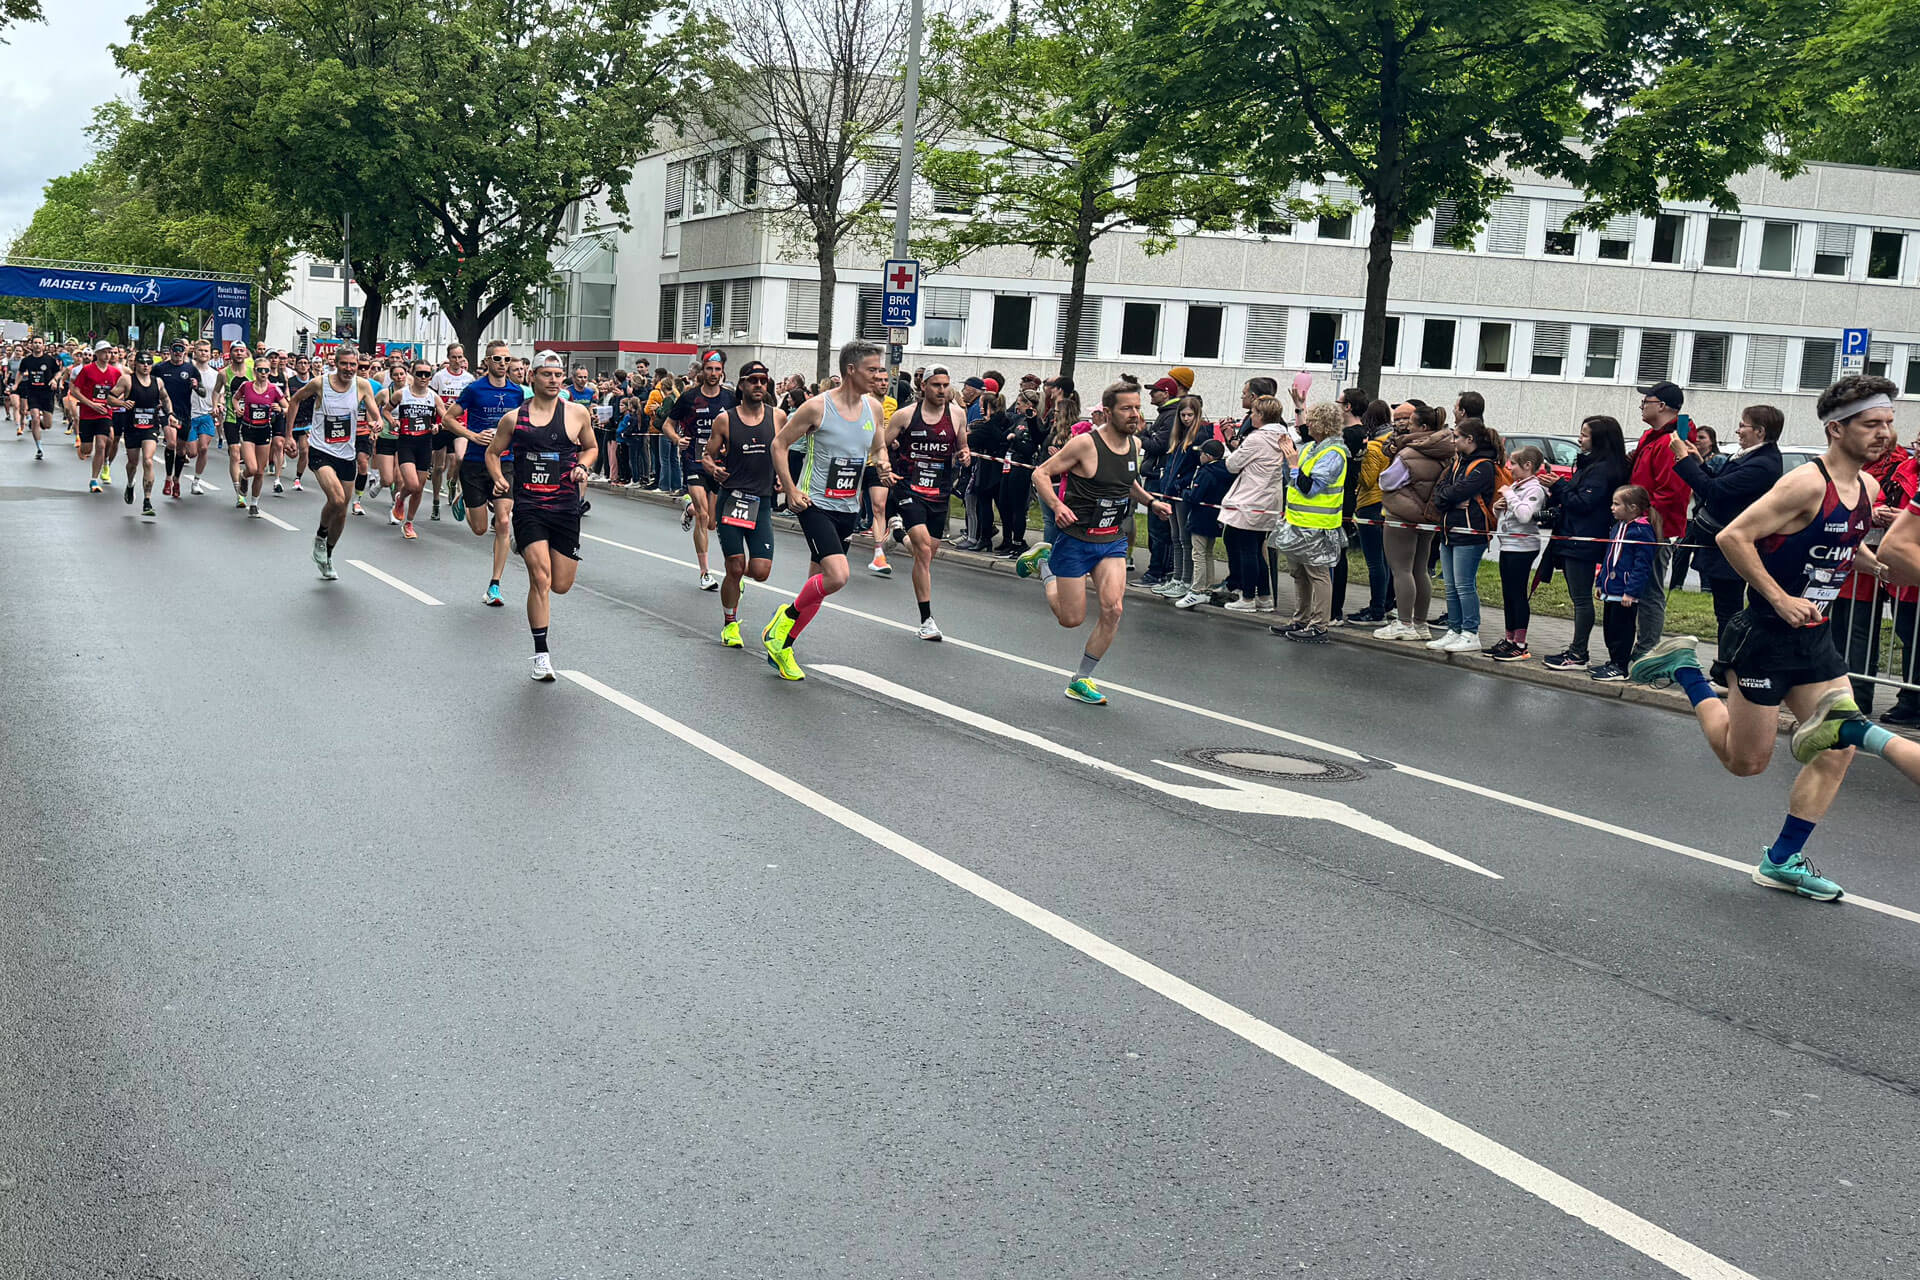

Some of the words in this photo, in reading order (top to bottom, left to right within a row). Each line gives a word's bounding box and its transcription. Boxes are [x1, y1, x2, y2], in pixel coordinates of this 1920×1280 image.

[39, 278, 97, 291] MAISEL'S
[100, 282, 143, 294] FunRun
[889, 295, 910, 306] BRK
[217, 305, 247, 319] START
[888, 306, 899, 316] 90
[901, 309, 911, 317] m
[1847, 331, 1862, 354] P
[1336, 342, 1345, 359] P
[910, 442, 950, 452] CHMS
[531, 472, 550, 484] 507
[836, 478, 855, 489] 644
[918, 477, 934, 488] 381
[731, 508, 749, 520] 414
